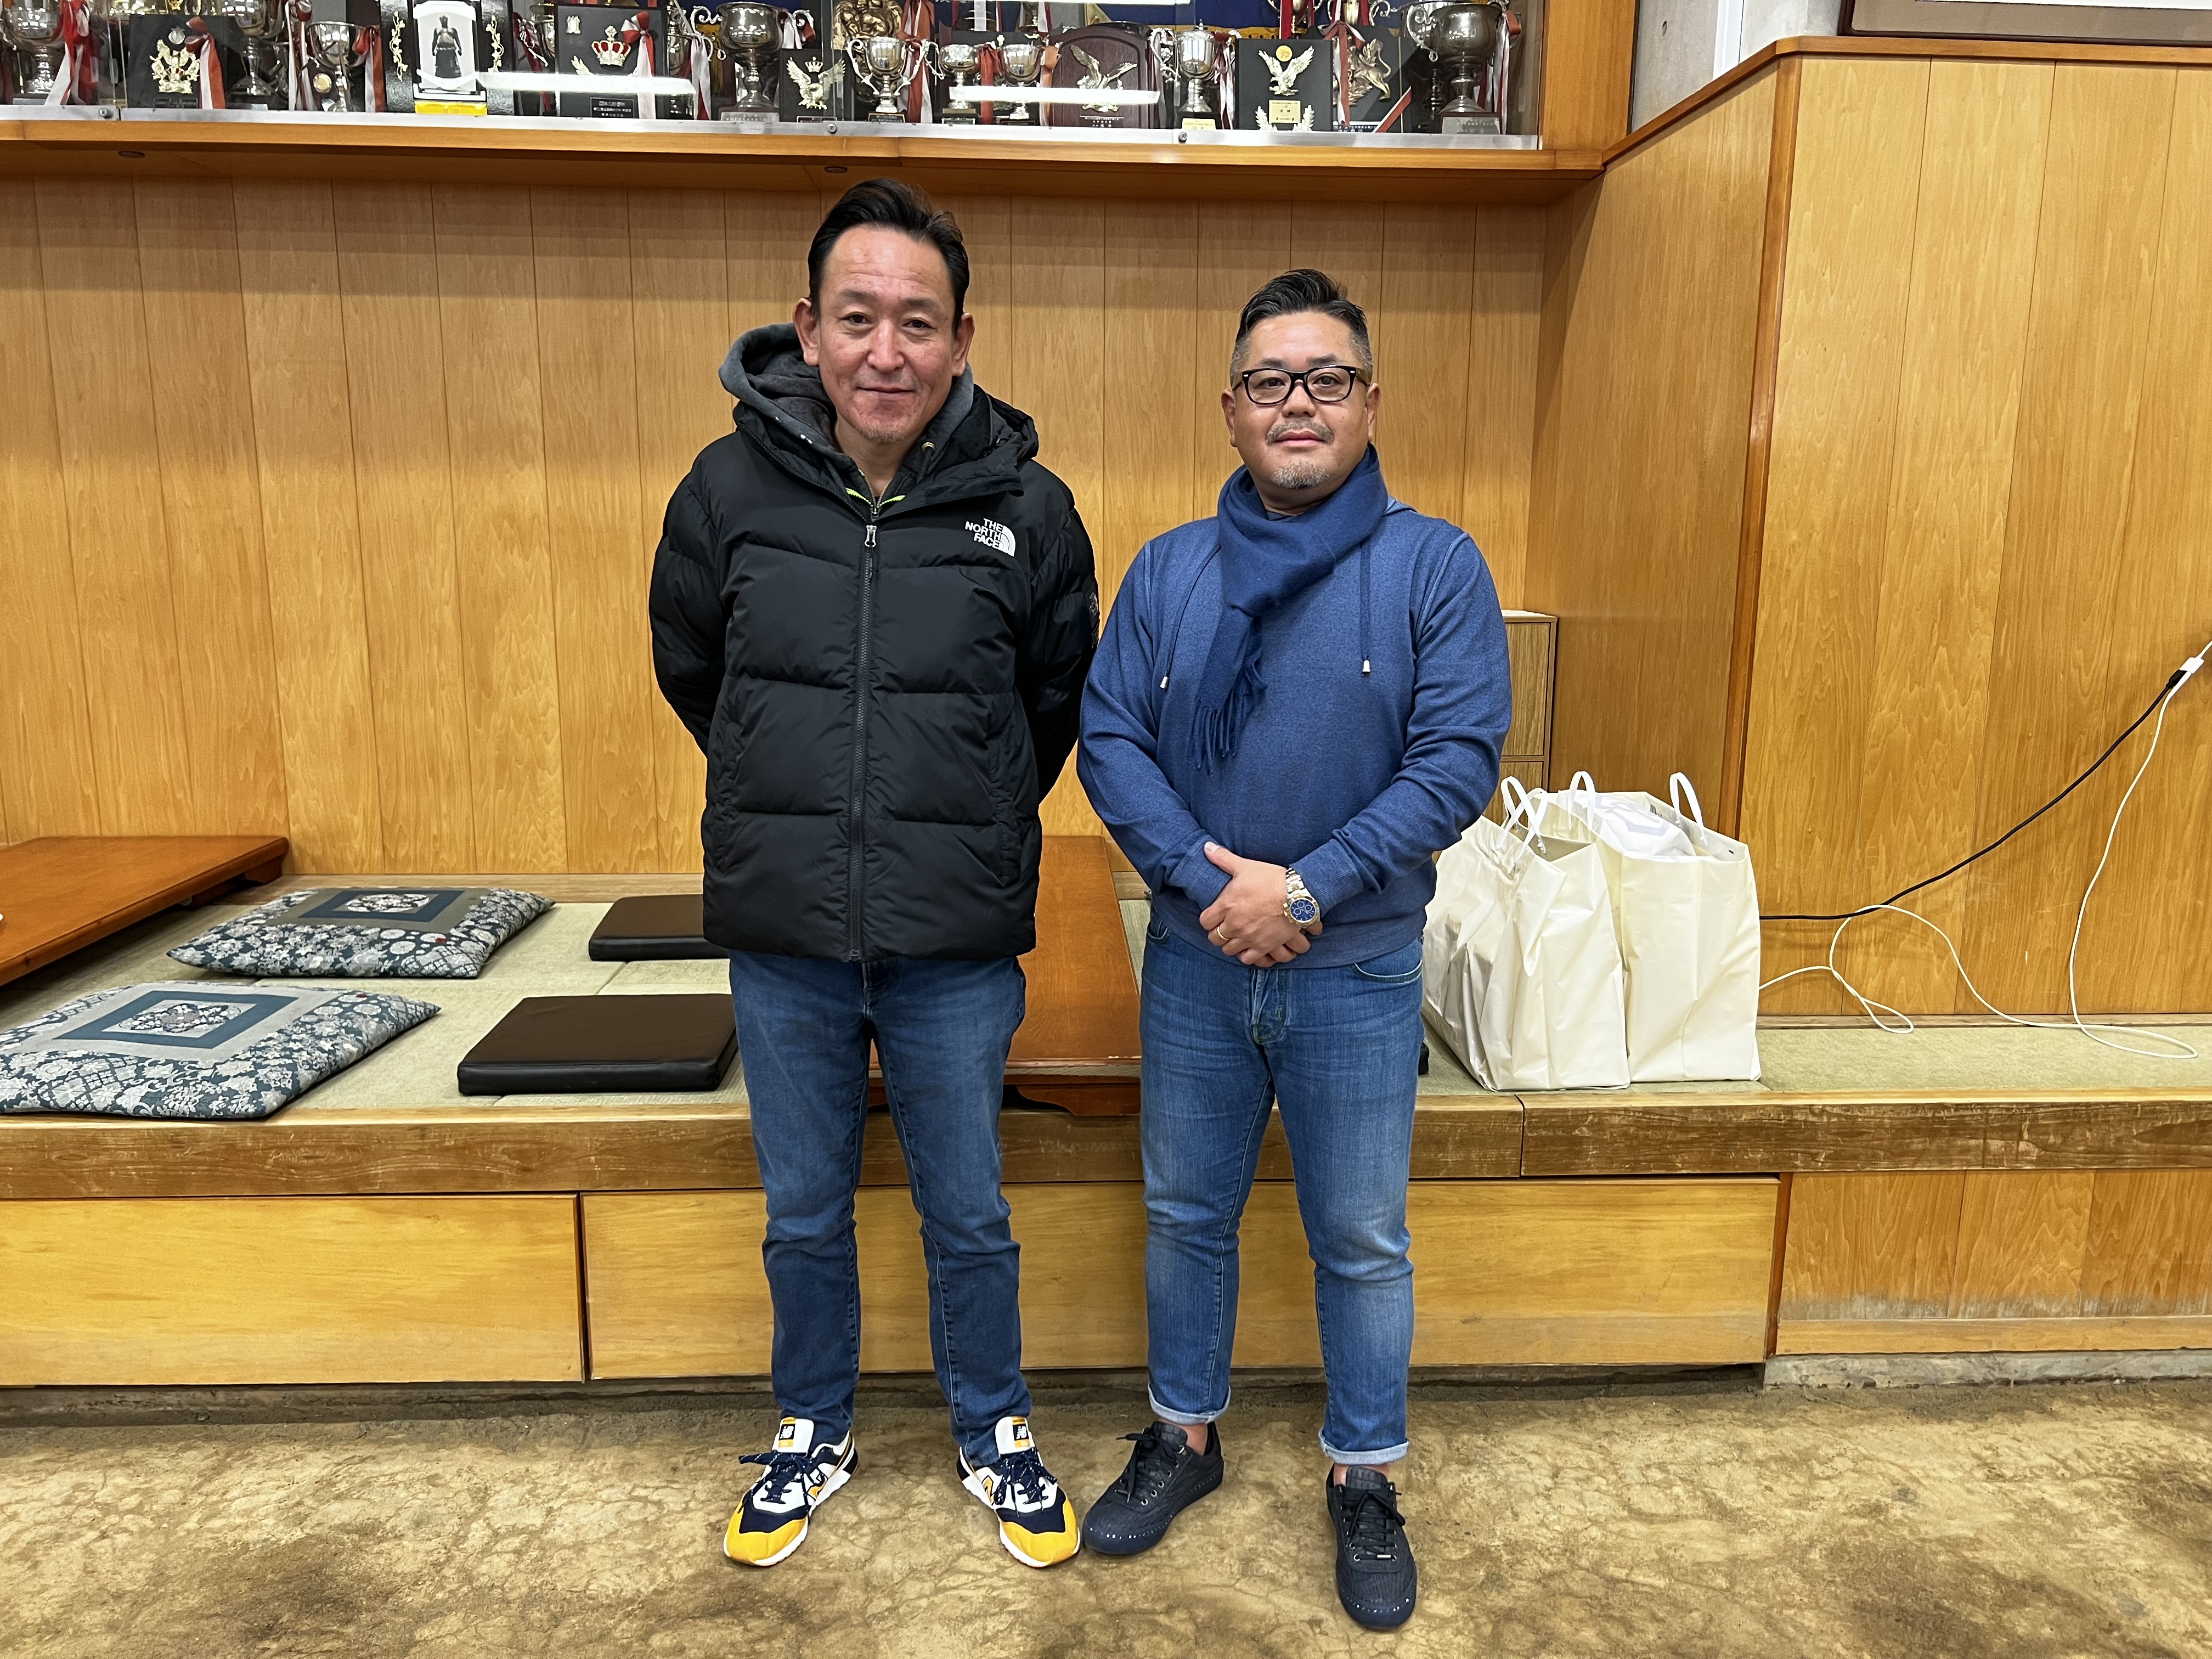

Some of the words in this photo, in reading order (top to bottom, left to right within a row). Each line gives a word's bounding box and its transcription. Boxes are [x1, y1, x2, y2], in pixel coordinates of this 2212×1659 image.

[965, 521, 1001, 541] NORTH
[983, 518, 1003, 533] THE
[973, 532, 1000, 549] FACE
